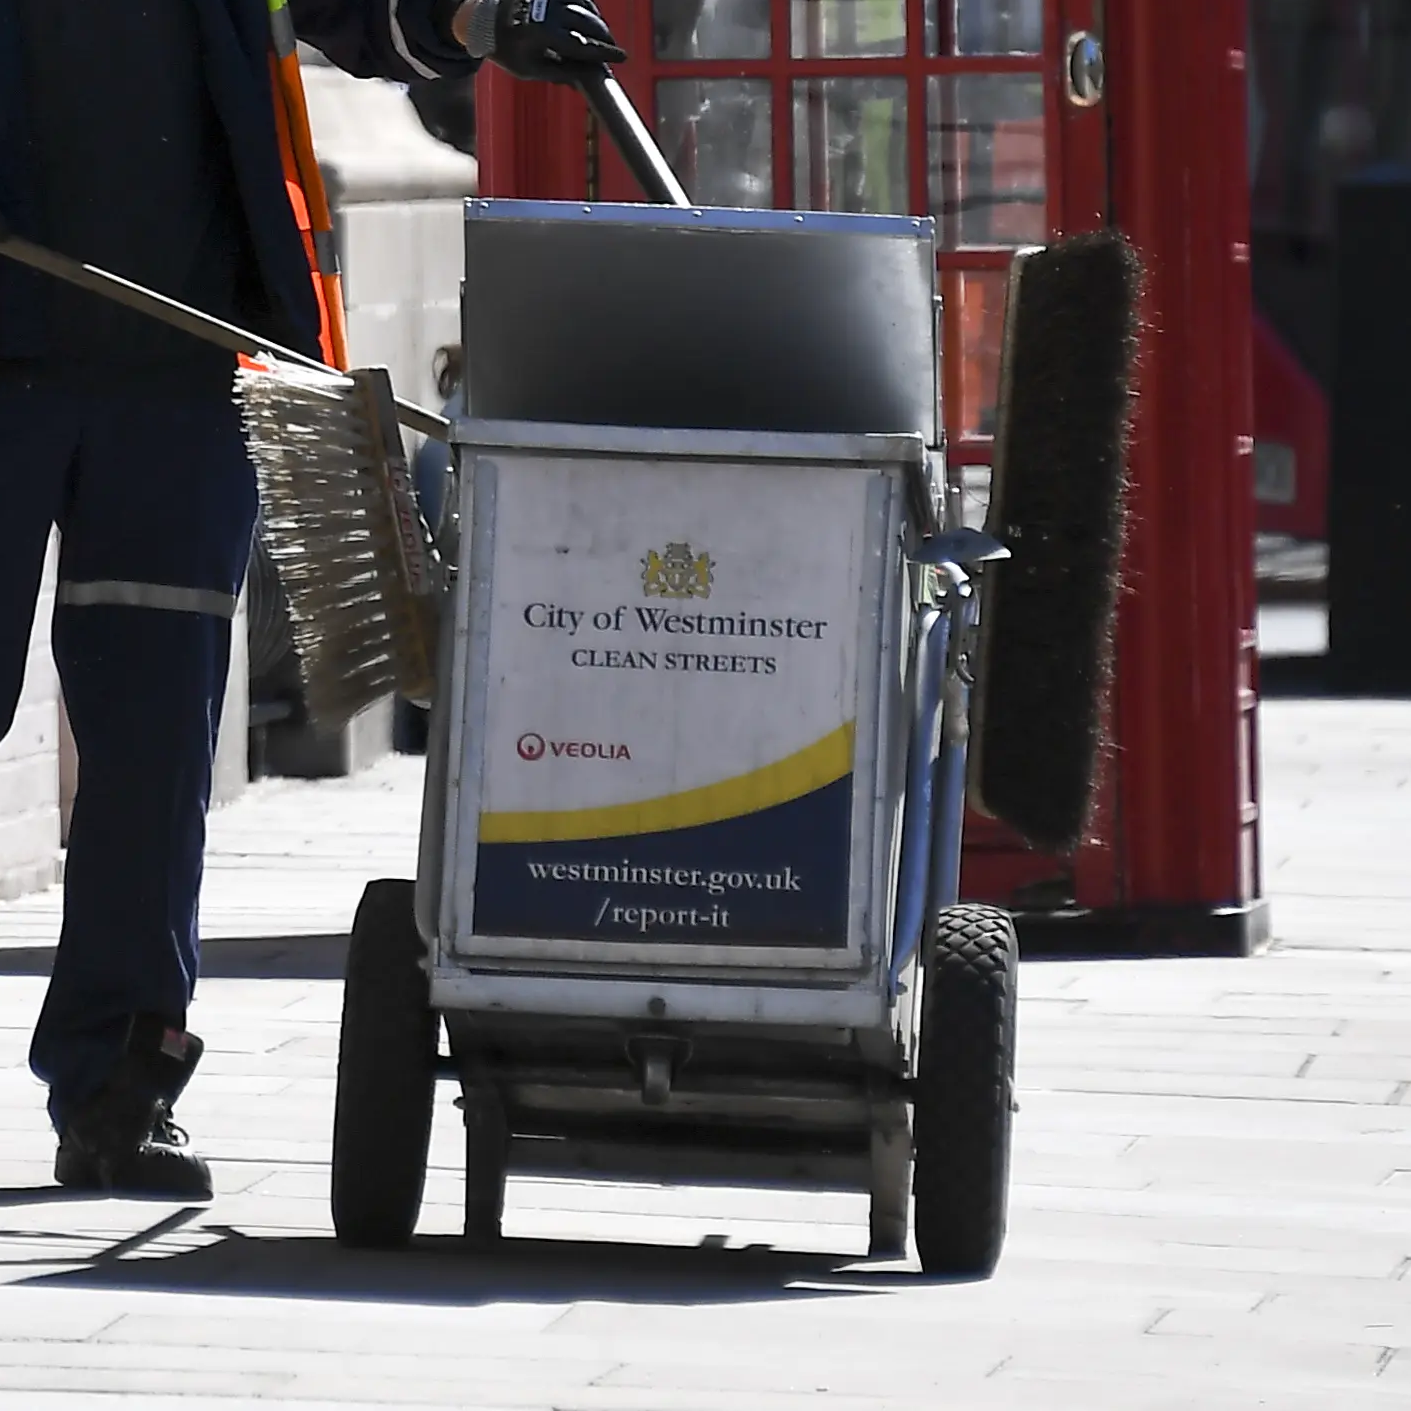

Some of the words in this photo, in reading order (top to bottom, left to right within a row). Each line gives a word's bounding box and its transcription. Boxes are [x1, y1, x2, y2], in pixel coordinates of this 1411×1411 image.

[522, 602, 583, 637] City
[594, 604, 626, 633] of
[635, 606, 828, 640] Westminster
[571, 648, 658, 671] CLEAN
[665, 652, 777, 675] STREETS
[550, 740, 632, 761] VEOLIA
[528, 859, 802, 895] westminster.gov.uk
[594, 898, 730, 932] /report-it
